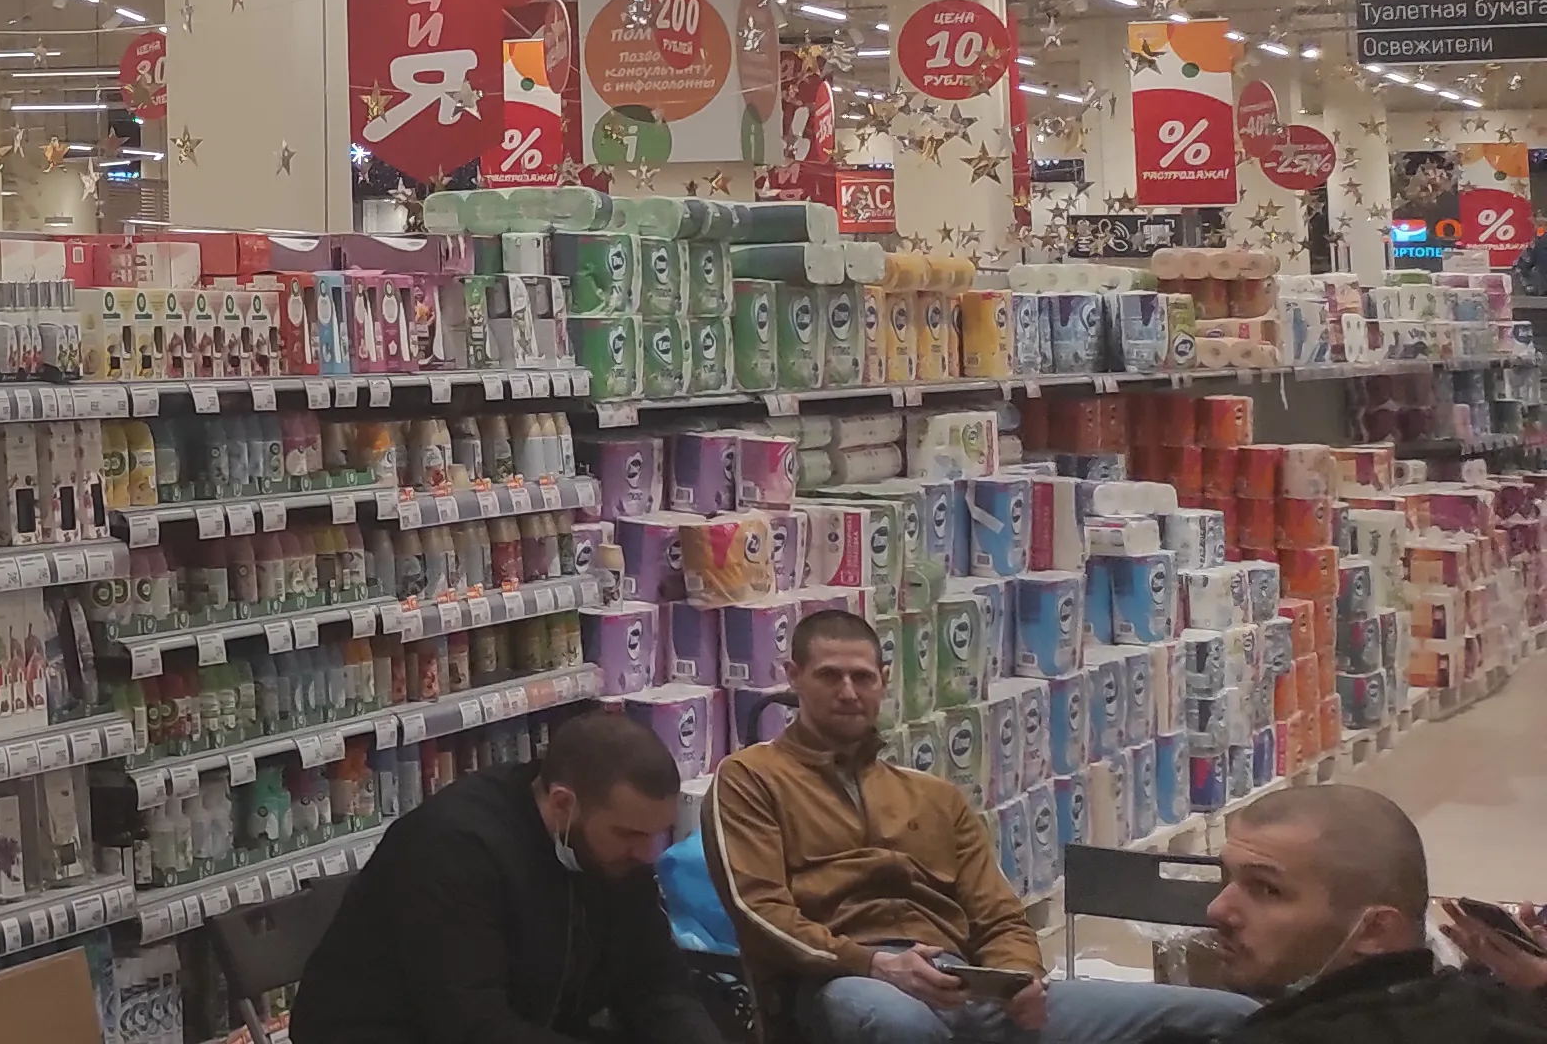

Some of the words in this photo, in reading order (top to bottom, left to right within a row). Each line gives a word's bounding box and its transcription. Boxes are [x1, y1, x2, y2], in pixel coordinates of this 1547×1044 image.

[933, 11, 975, 27] ЦЕНА
[1361, 0, 1467, 24] Туалетная
[663, 39, 693, 55] РУБЛЕЙ
[925, 30, 983, 68] 10
[1363, 34, 1493, 57] Освежители
[923, 74, 983, 88] РУБЛ
[501, 128, 543, 172] %
[1159, 118, 1211, 168] %
[1478, 208, 1515, 243] %
